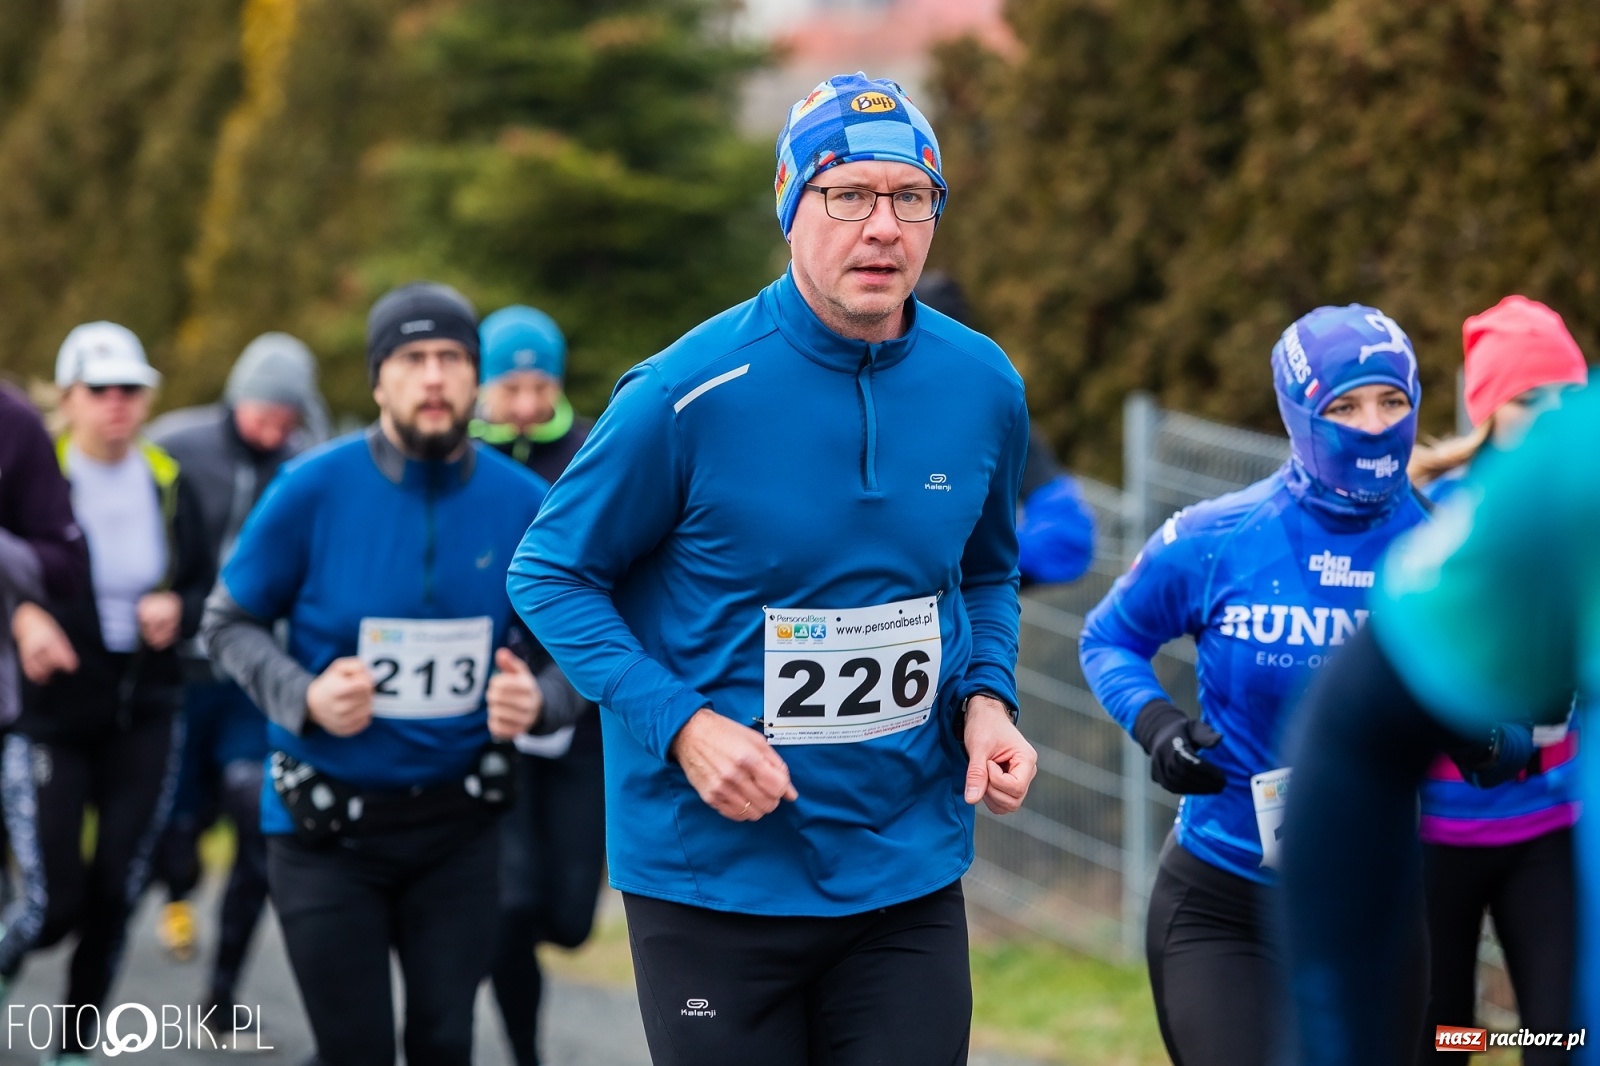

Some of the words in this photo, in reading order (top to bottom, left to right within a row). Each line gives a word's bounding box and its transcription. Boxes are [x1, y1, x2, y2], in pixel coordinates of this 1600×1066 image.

[924, 483, 952, 492] Kalenji
[776, 615, 827, 623] PersonalBest
[836, 612, 933, 635] www.personalbest.pl
[1220, 604, 1372, 646] RUNN
[1256, 651, 1335, 668] EKO-OK
[373, 657, 476, 697] 213
[776, 650, 931, 718] 226
[680, 1008, 717, 1018] Kalenji
